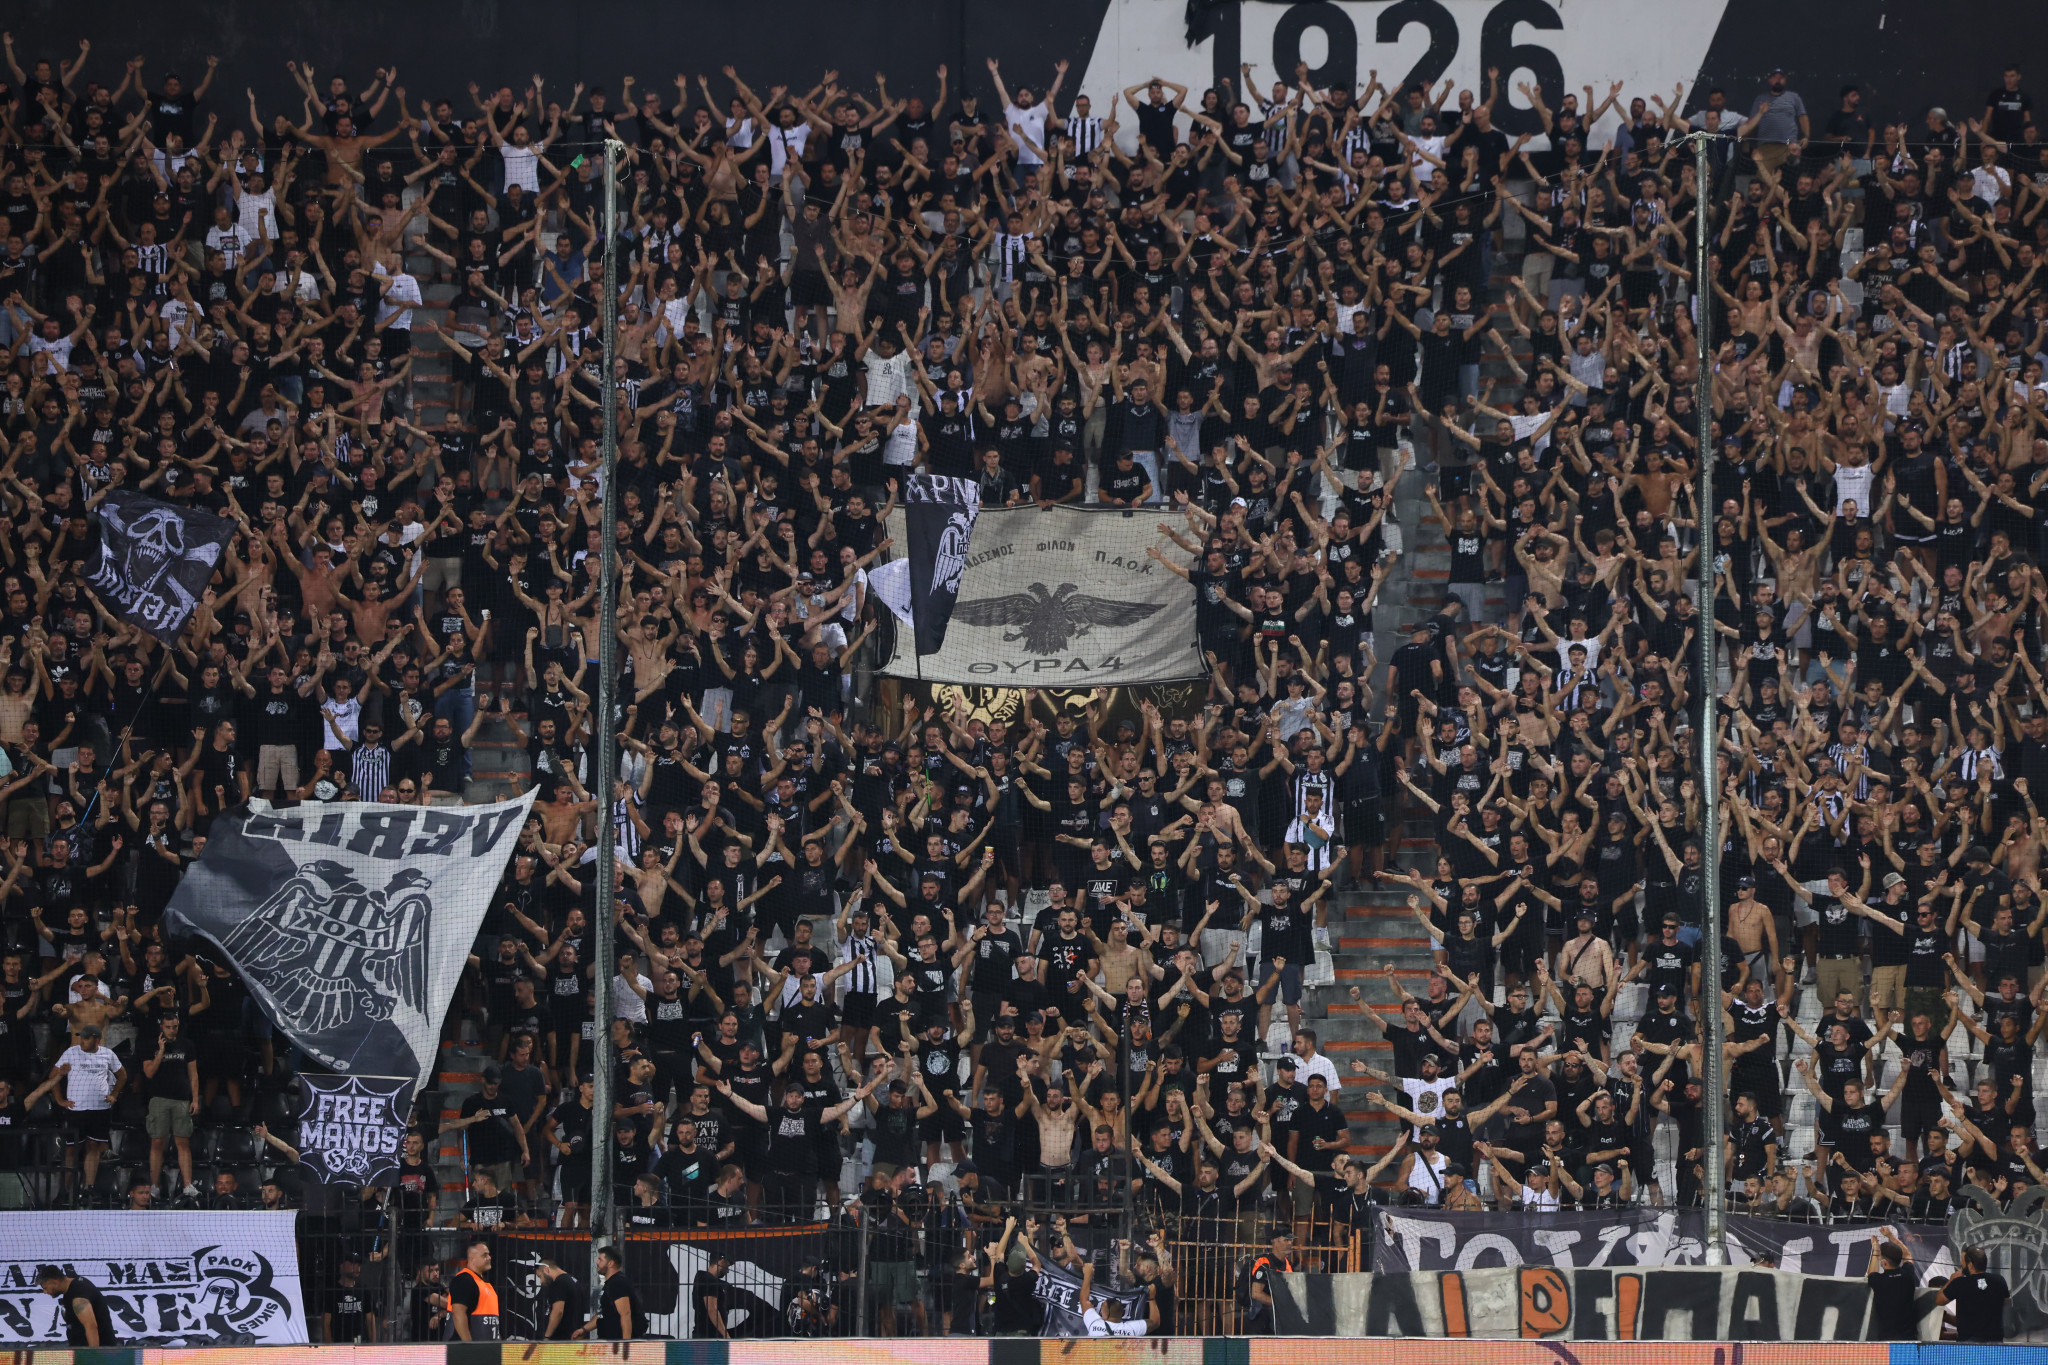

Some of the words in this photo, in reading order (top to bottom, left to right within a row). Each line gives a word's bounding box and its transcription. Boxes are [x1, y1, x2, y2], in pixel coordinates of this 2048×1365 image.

[1186, 0, 1565, 137] 1926
[1037, 539, 1075, 552] ΦΙΛΩΝ
[507, 576, 529, 589] HGO
[968, 657, 1091, 674] ΘΥΡΑ
[1098, 657, 1124, 670] 4
[318, 1094, 388, 1126] FREE
[300, 1123, 399, 1155] MANOS
[207, 1256, 258, 1272] PAOK
[1034, 1274, 1075, 1309] REE
[237, 1302, 279, 1333] SIKIES
